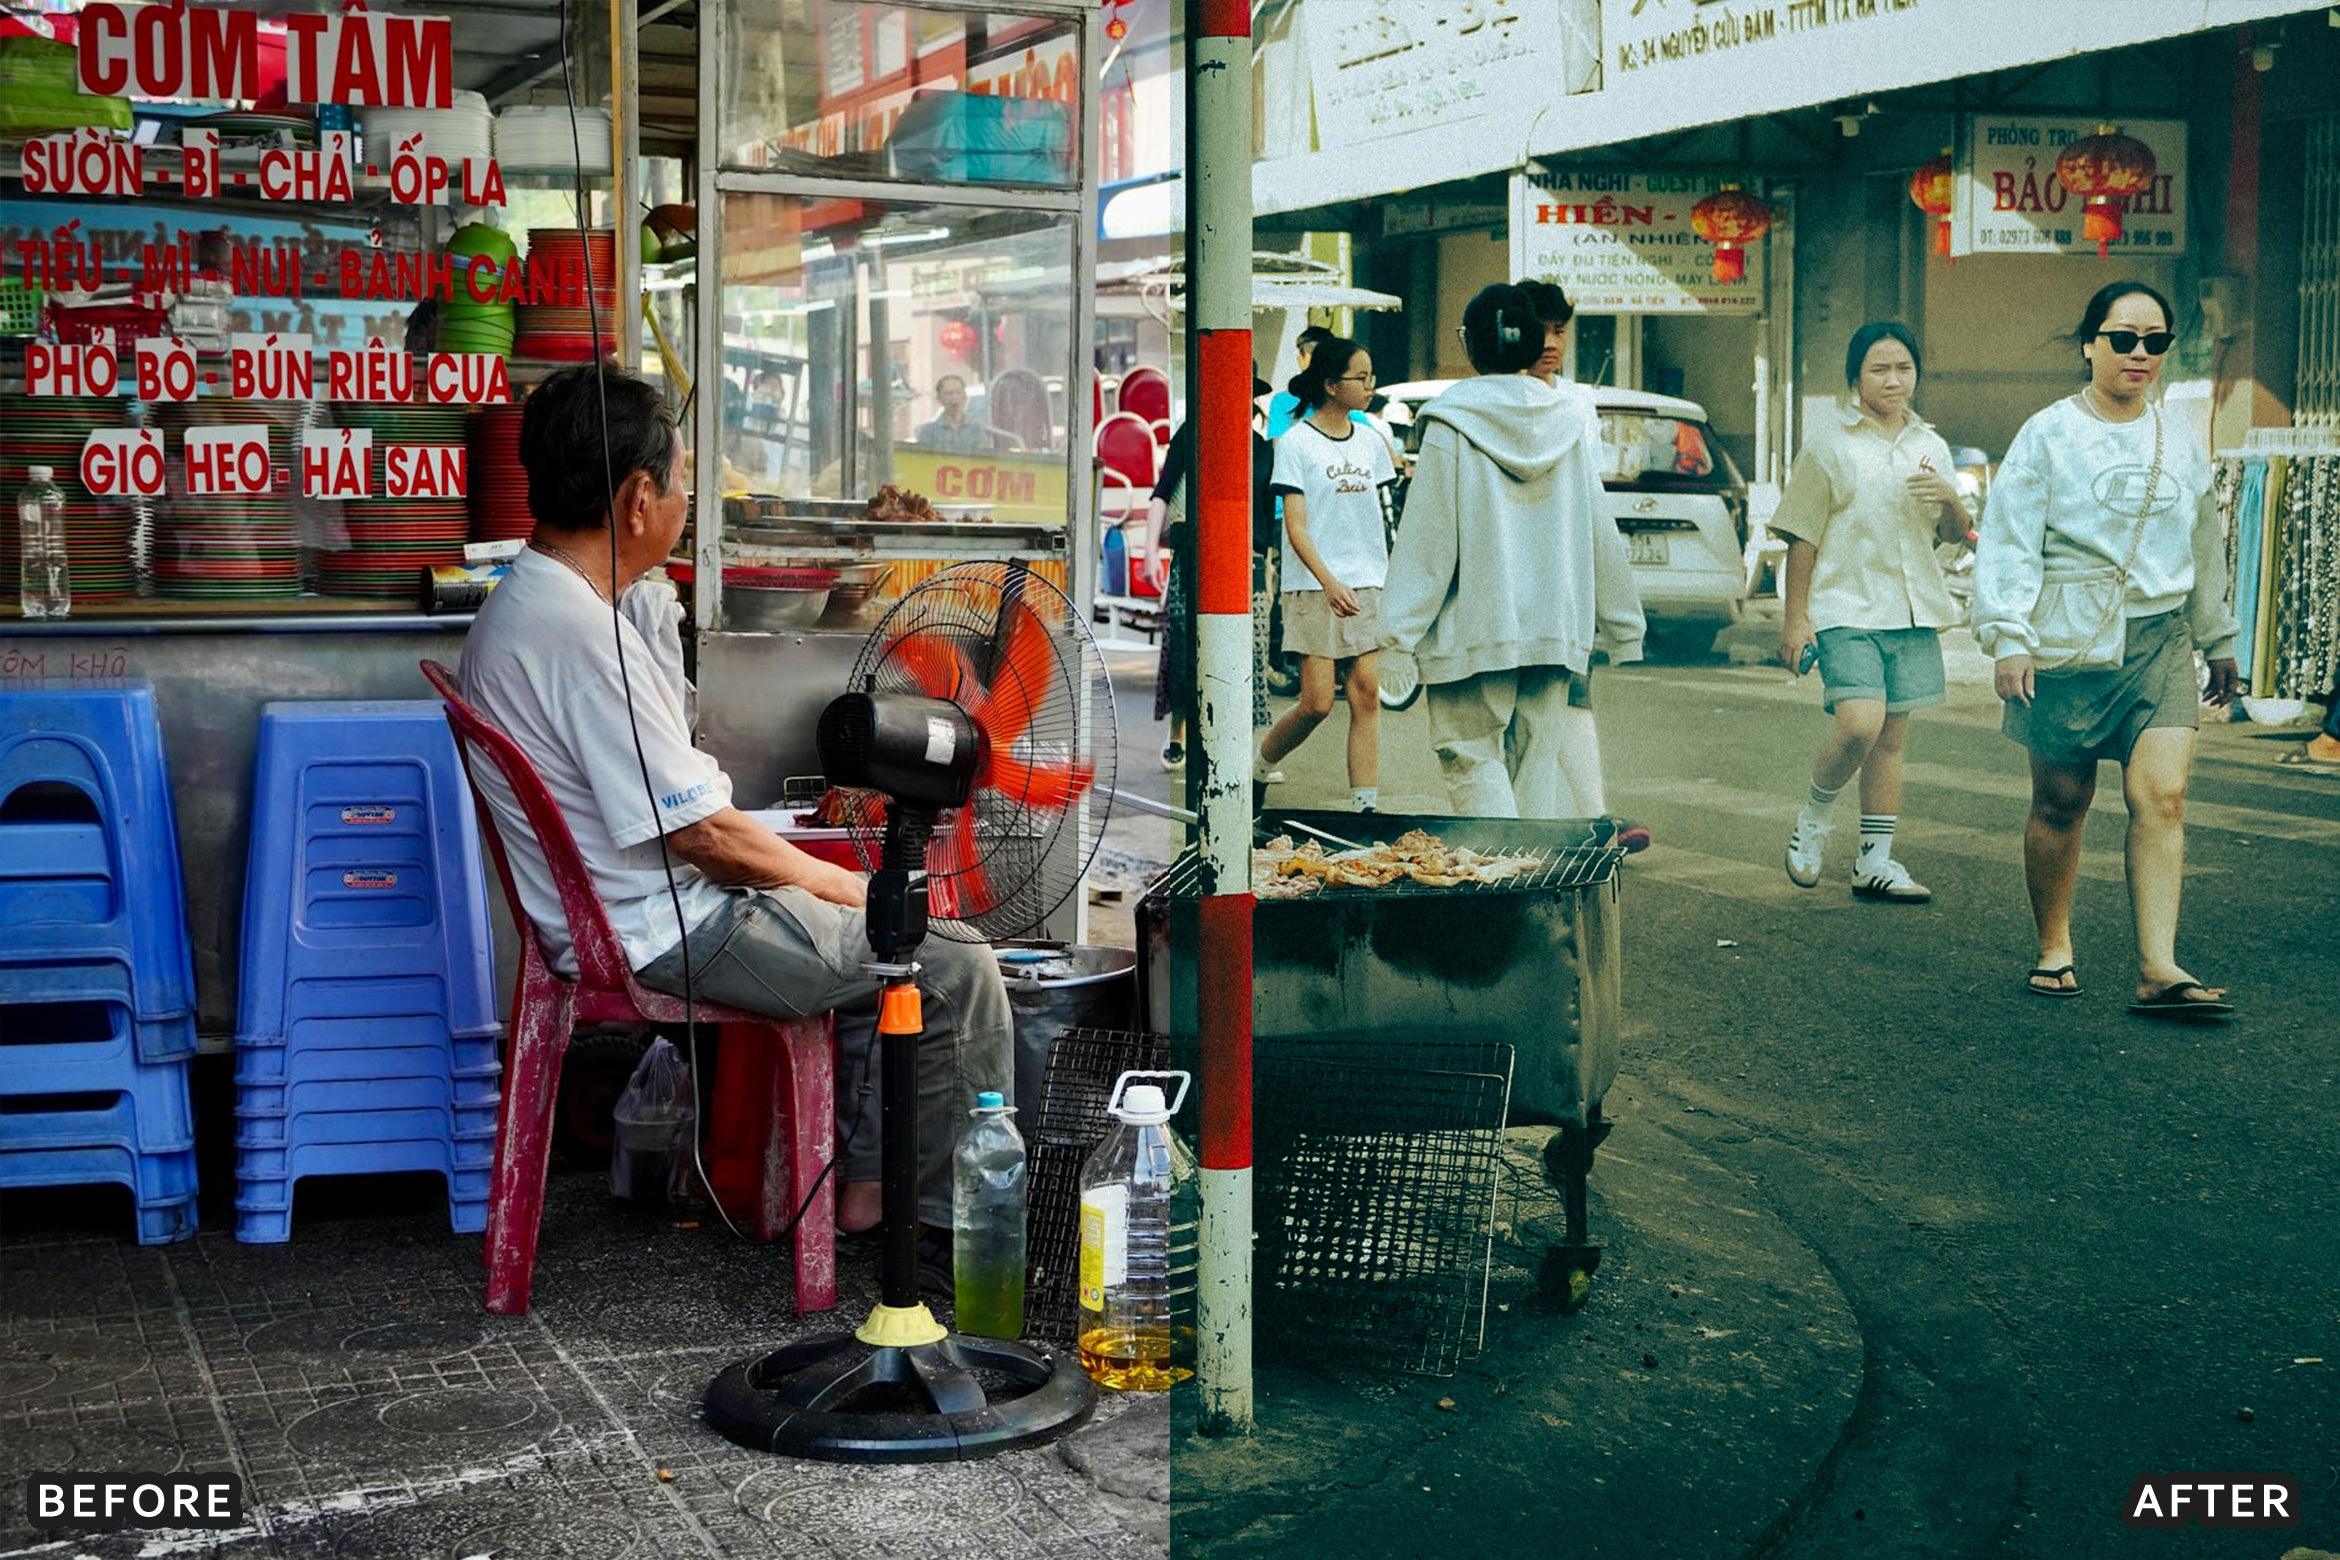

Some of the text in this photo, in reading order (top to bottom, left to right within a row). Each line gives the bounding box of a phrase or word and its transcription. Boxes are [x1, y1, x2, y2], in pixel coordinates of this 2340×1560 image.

[78, 1, 259, 99] CƠM
[23, 127, 507, 207] SƯỜN BÌ CHẢ ỐP LA
[1993, 156, 2067, 212] BẢO
[17, 218, 102, 293] TIẾU
[142, 228, 192, 294] MÌ
[231, 245, 300, 298] NUI
[466, 254, 584, 306] CANH
[137, 337, 196, 401] BÒ
[232, 335, 313, 400] BÚN
[330, 336, 413, 402] RIÊU
[428, 353, 512, 404] CUA
[82, 428, 467, 498] GIÒ HEO HẢI SAN
[936, 464, 1036, 502] CƠM
[0, 649, 45, 676] ÔM
